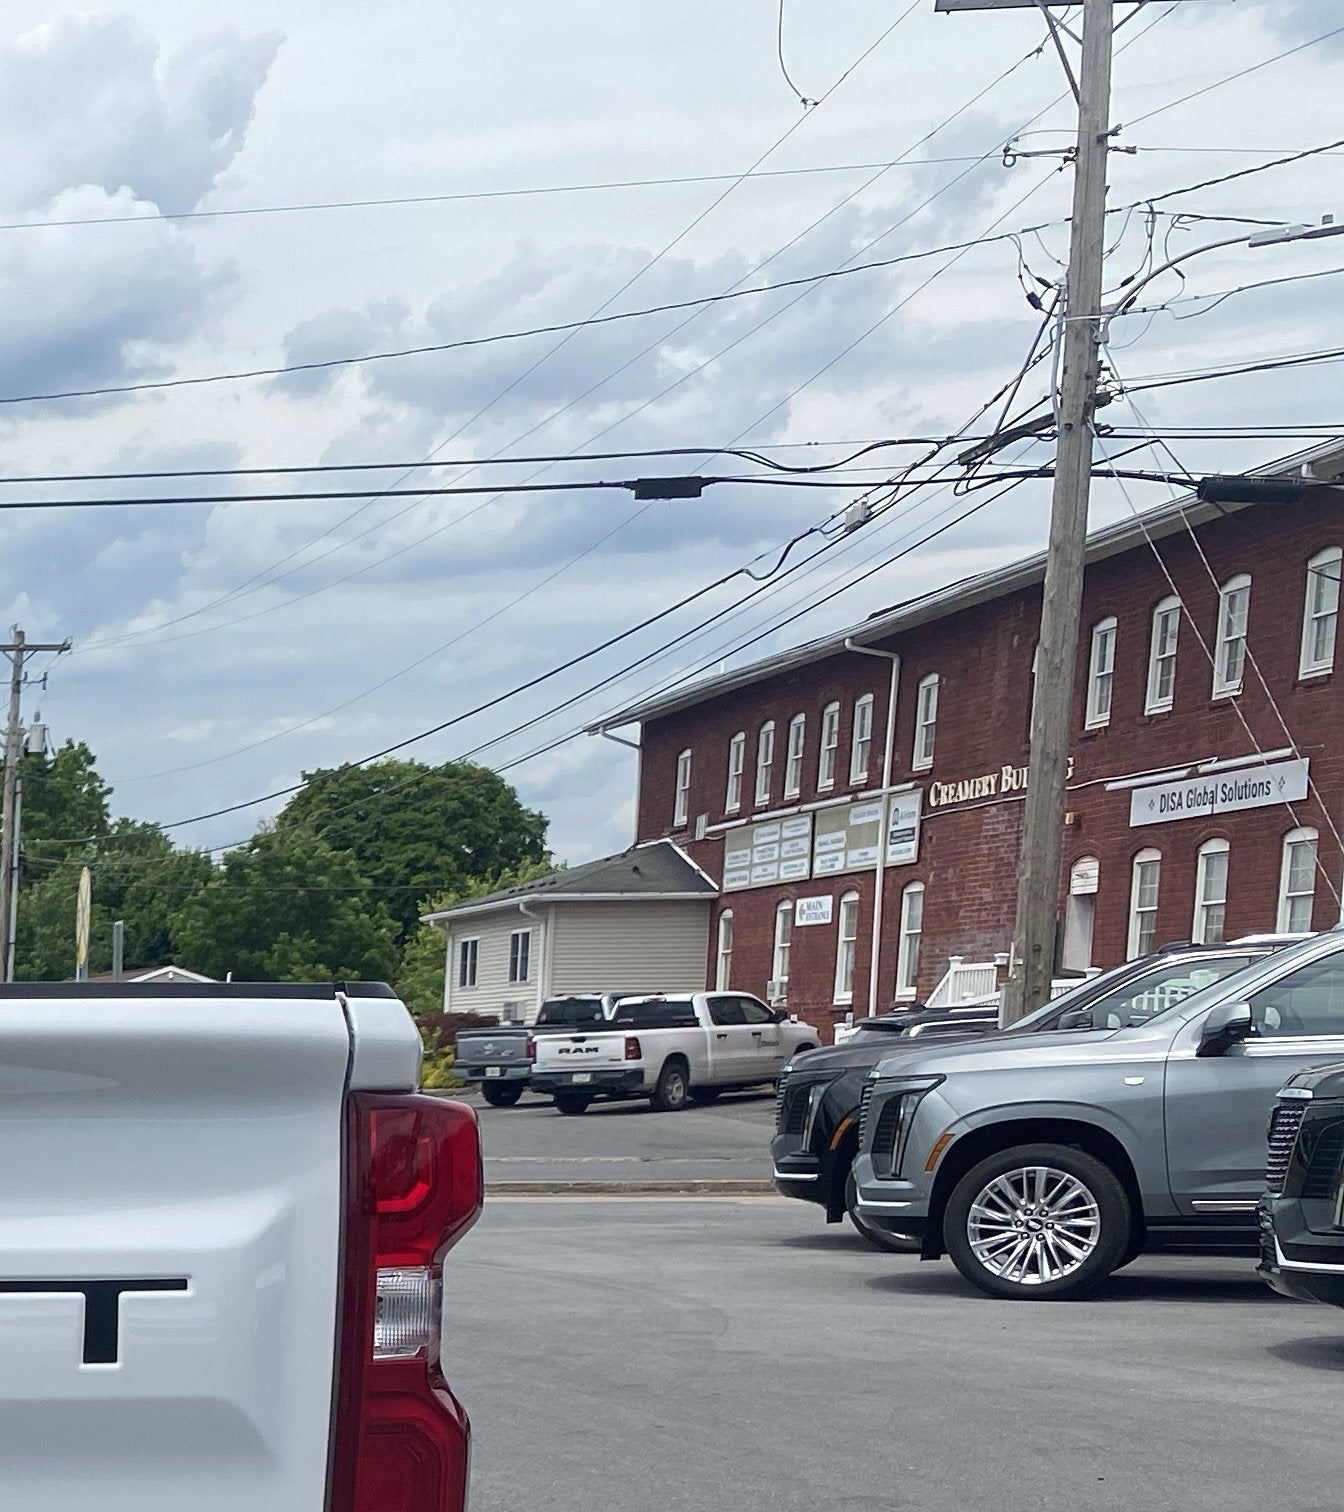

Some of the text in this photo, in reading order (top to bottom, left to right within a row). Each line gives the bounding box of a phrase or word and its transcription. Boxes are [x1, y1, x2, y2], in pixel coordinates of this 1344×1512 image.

[929, 773, 999, 807] CREAMERY
[1159, 777, 1272, 814] DISA Global Solutions
[558, 1046, 599, 1055] RAM
